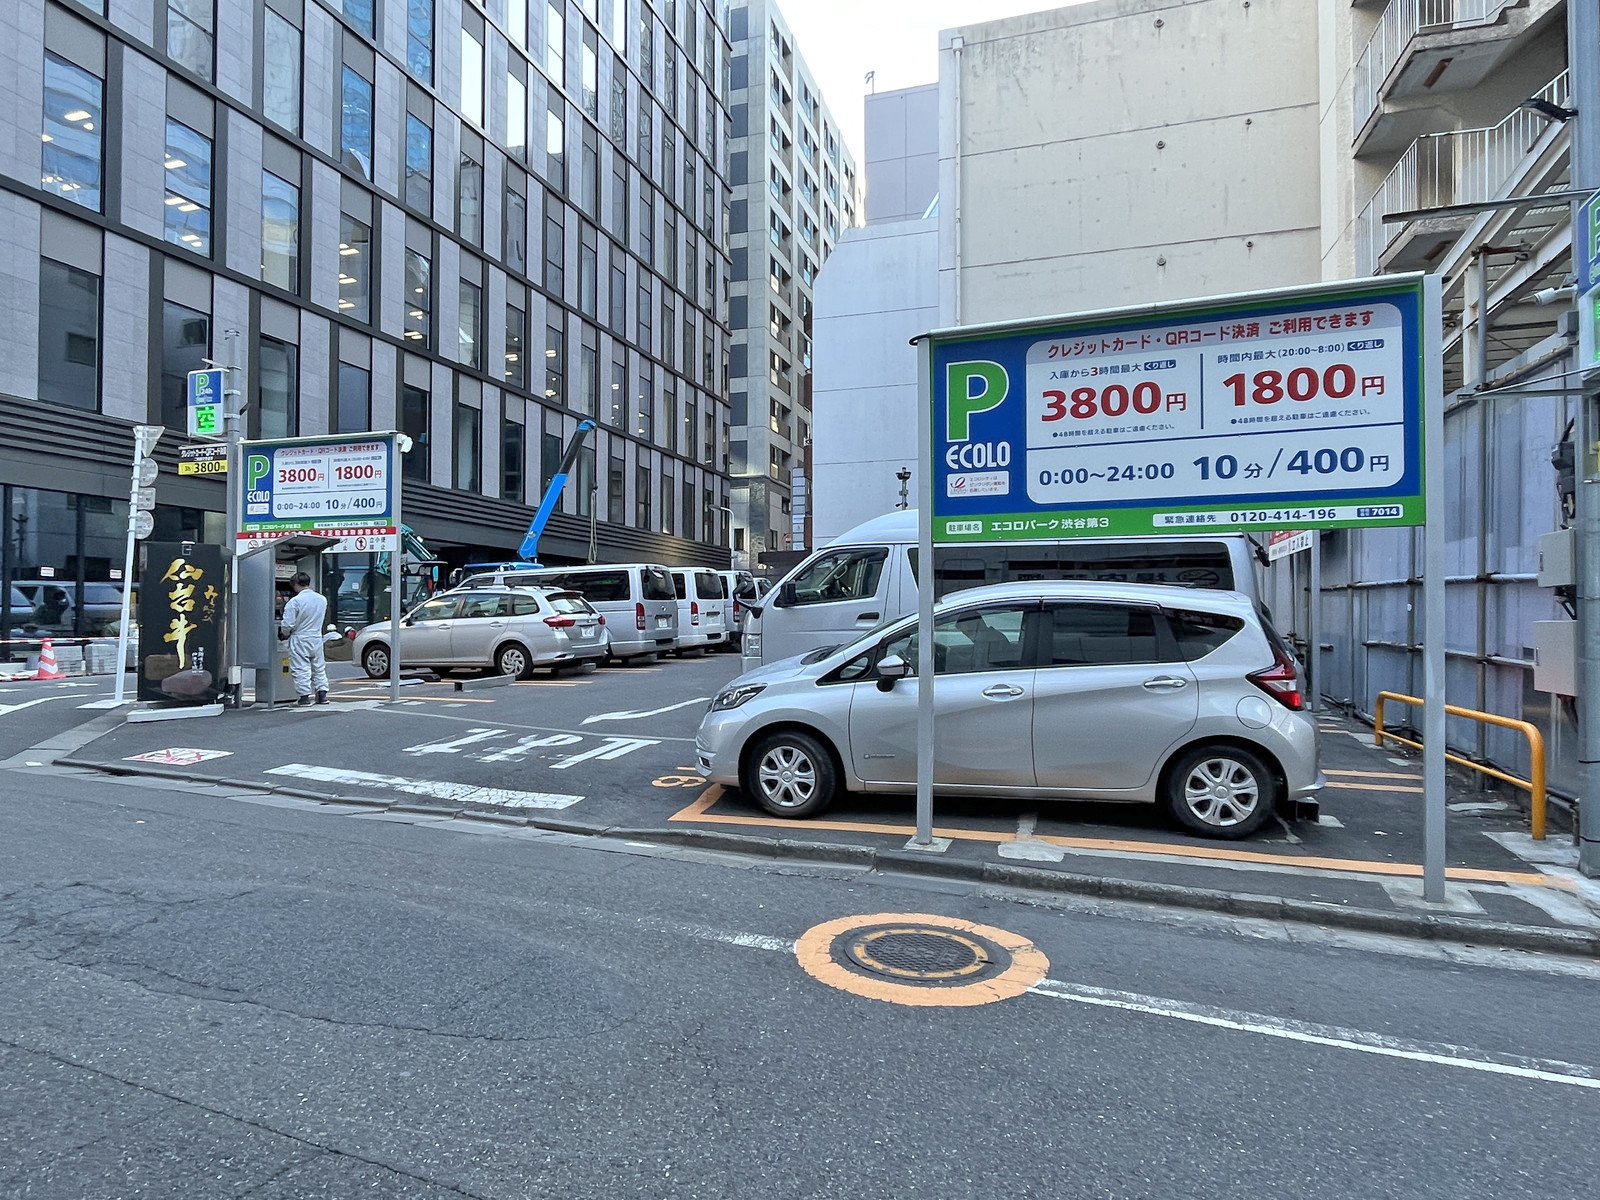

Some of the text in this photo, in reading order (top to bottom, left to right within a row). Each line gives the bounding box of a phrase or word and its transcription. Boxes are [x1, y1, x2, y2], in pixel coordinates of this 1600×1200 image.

[1048, 310, 1374, 359] クレジットカード・QRコード決済 ご利用できます
[1349, 339, 1384, 351] くり返し
[1050, 360, 1176, 380] 入庫から3時間最大 くり返し
[196, 374, 209, 396] P
[1223, 363, 1385, 406] 1800円
[946, 360, 1010, 442] P
[1041, 381, 1187, 422] 3800円
[946, 441, 1011, 469] ECOLO
[247, 454, 270, 490] P
[278, 464, 382, 483] 3800円 1800円
[247, 490, 270, 502] ECOLO
[1230, 508, 1337, 523] 0120-414-196
[1371, 507, 1398, 516] 7014
[160, 558, 204, 670] 仙台牛
